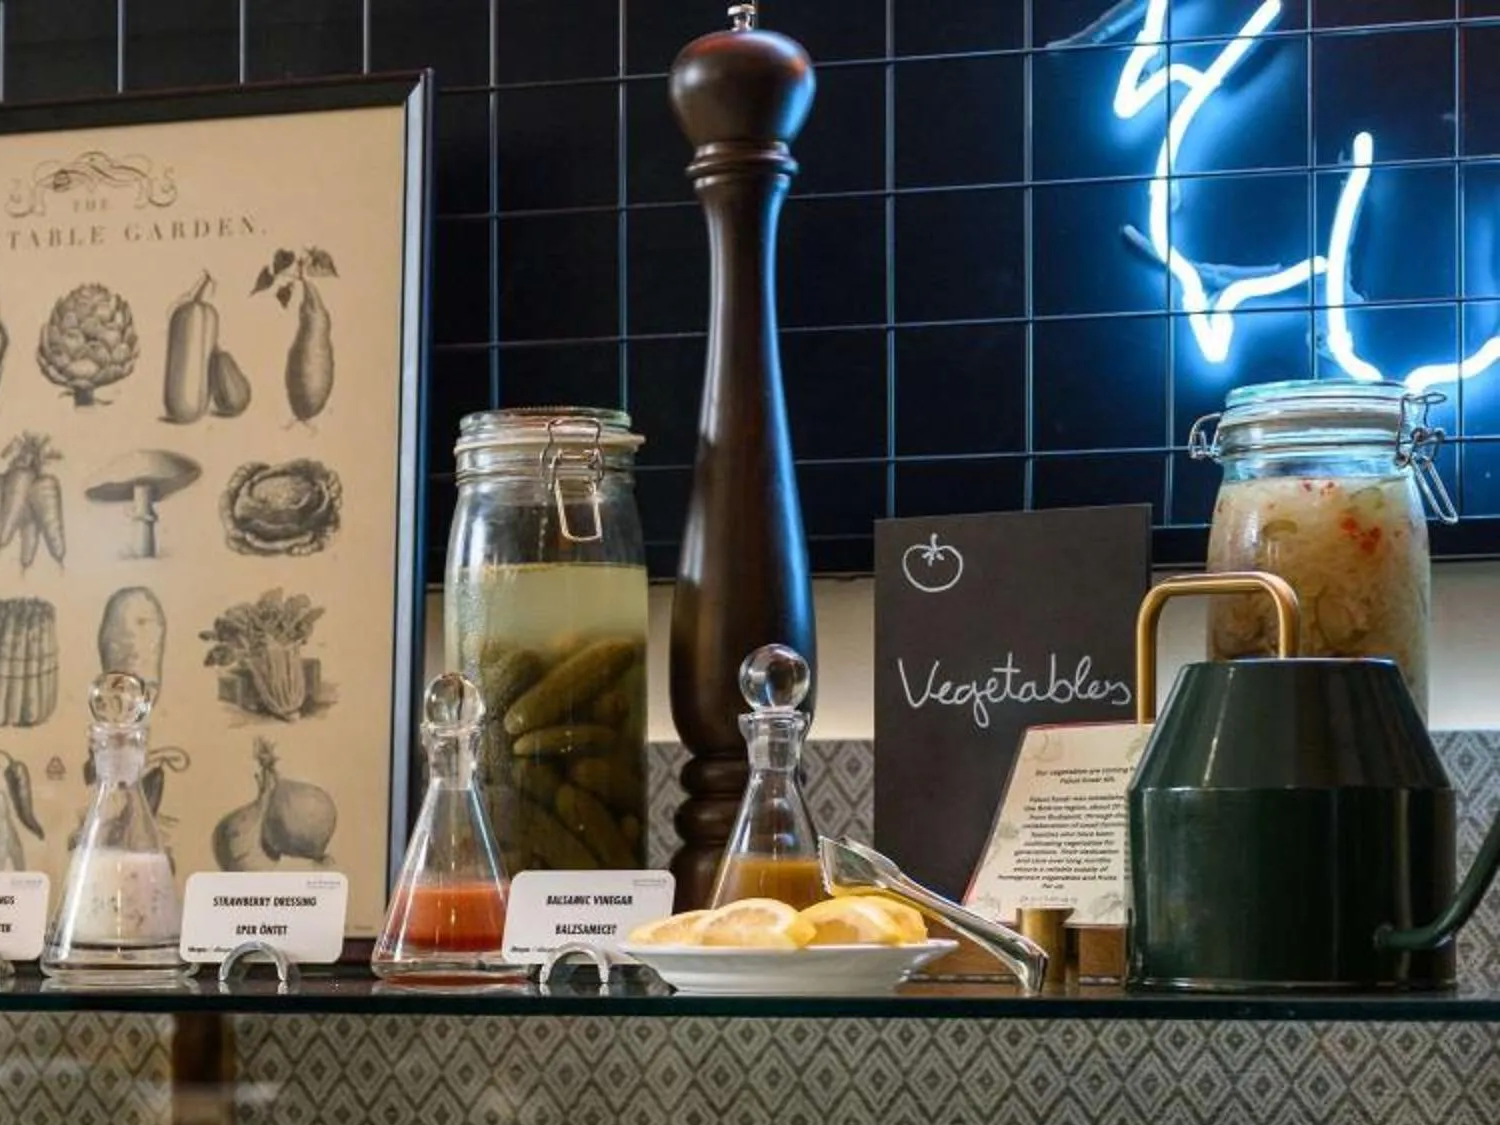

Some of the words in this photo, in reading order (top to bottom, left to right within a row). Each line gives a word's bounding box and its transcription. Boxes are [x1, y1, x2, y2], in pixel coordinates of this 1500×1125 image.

[897, 651, 1133, 729] Vegetables
[212, 895, 270, 908] STRAWBERRY
[272, 895, 318, 907] DRESSING
[546, 895, 591, 906] BALSAMIC
[592, 895, 633, 906] VINEGAR
[235, 924, 257, 936] EPER
